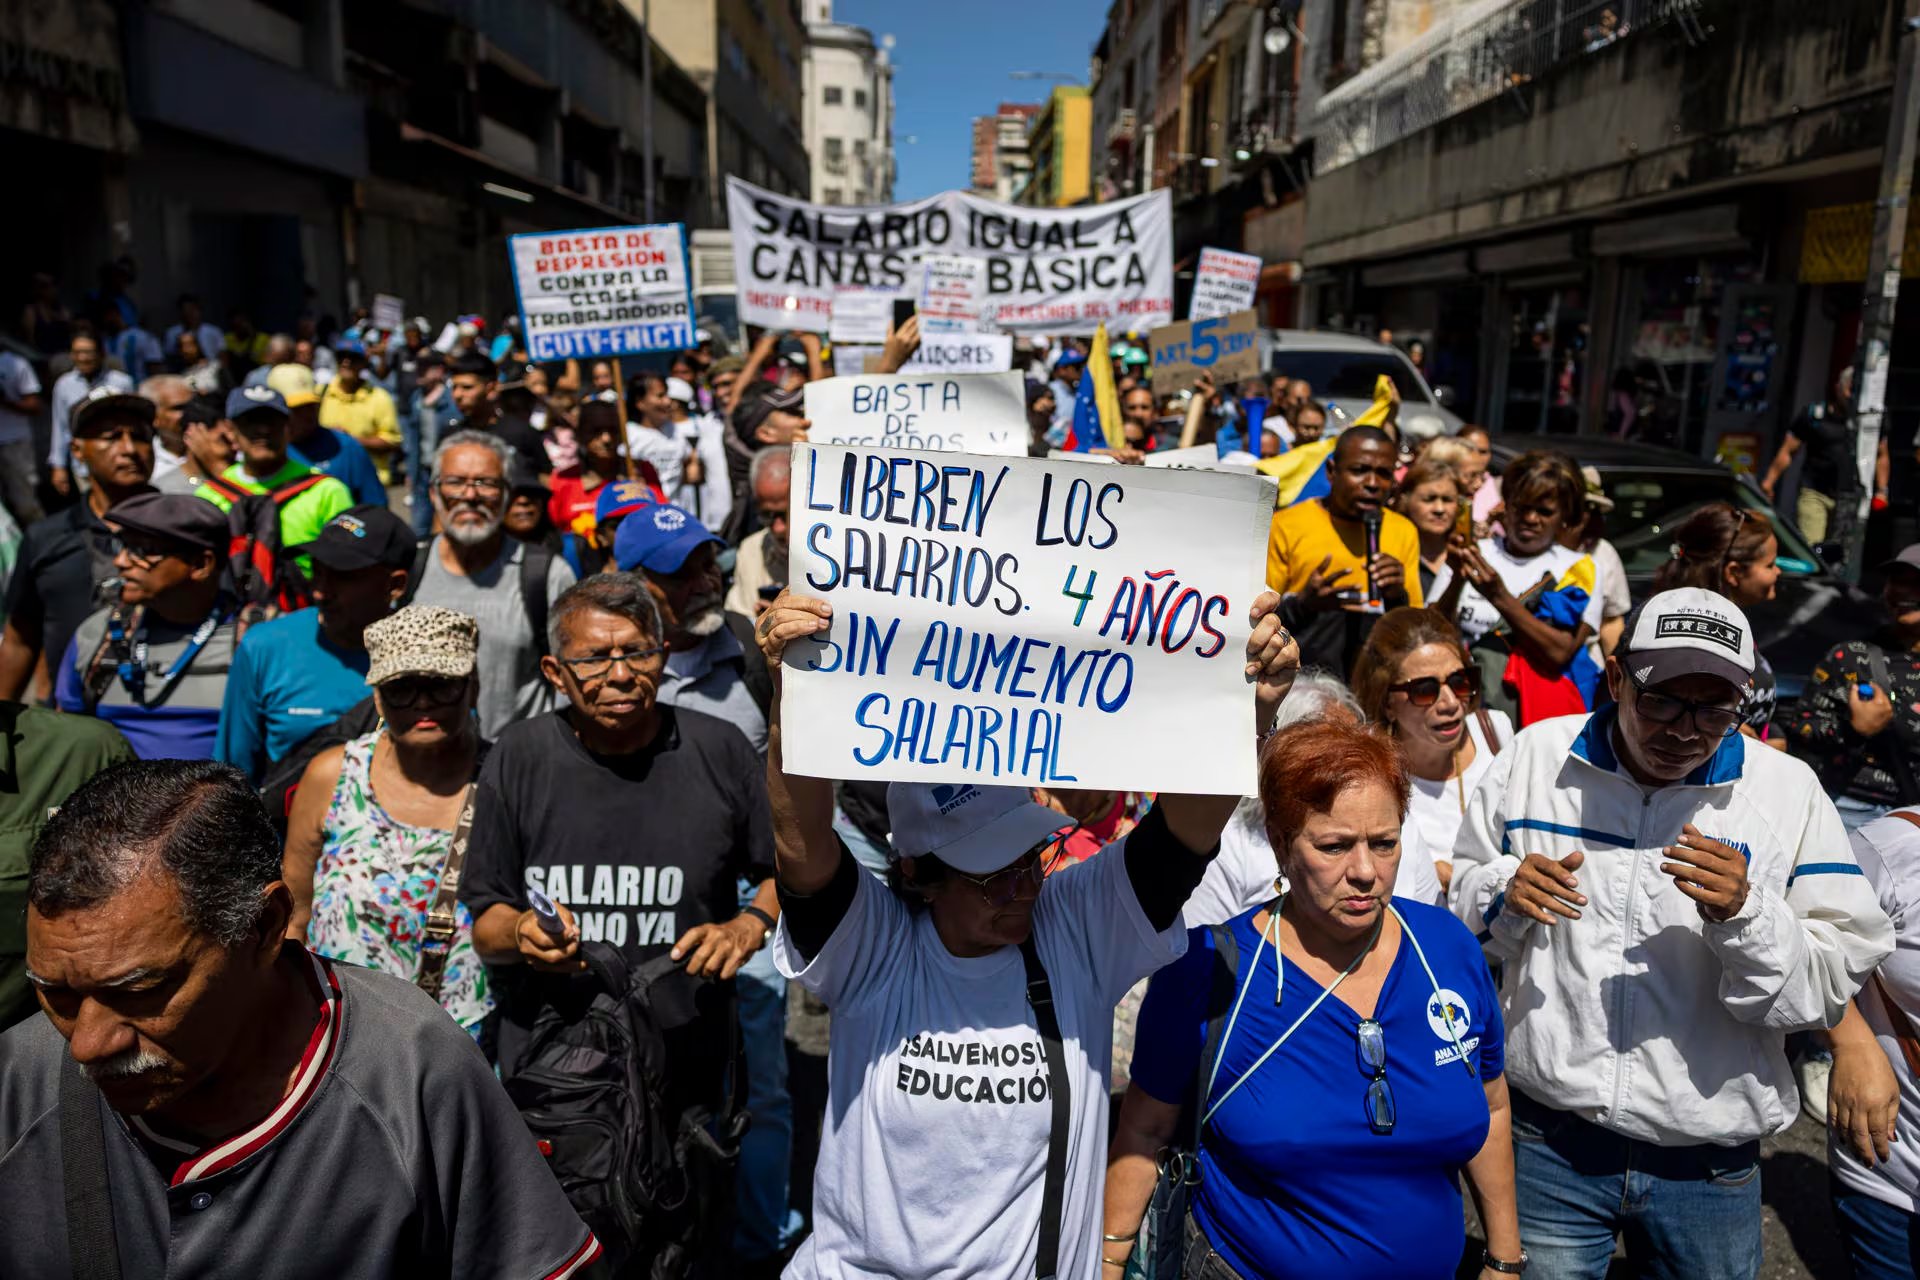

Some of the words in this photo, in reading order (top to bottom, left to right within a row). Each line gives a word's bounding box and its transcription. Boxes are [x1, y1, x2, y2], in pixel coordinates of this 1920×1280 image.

[753, 199, 952, 248] SALARIO
[969, 210, 1098, 249] IGUAL
[1114, 209, 1136, 245] A
[540, 235, 618, 255] BASTA
[626, 233, 653, 248] DE
[536, 250, 667, 273] REPRESION
[752, 244, 922, 287] CANAS
[539, 272, 633, 292] CONTRA
[641, 268, 669, 283] LA
[570, 288, 640, 307] CLASE
[529, 302, 688, 328] TRABAJADORA
[853, 380, 960, 413] BASTA
[885, 414, 919, 435] DE
[807, 448, 1010, 537] LIBEREN
[1035, 473, 1125, 549] LOS
[805, 522, 1031, 616] SALARIOS.
[1062, 565, 1098, 627] 4
[1098, 569, 1230, 659] AÑOS
[807, 612, 901, 676] SIN
[912, 621, 1134, 713] AUMENTO
[852, 692, 1078, 783] SALARIAL
[524, 865, 684, 906] SALARIO
[573, 911, 628, 947] NO
[636, 911, 676, 946] YA
[900, 1034, 1036, 1067] ¡SALVEMOS
